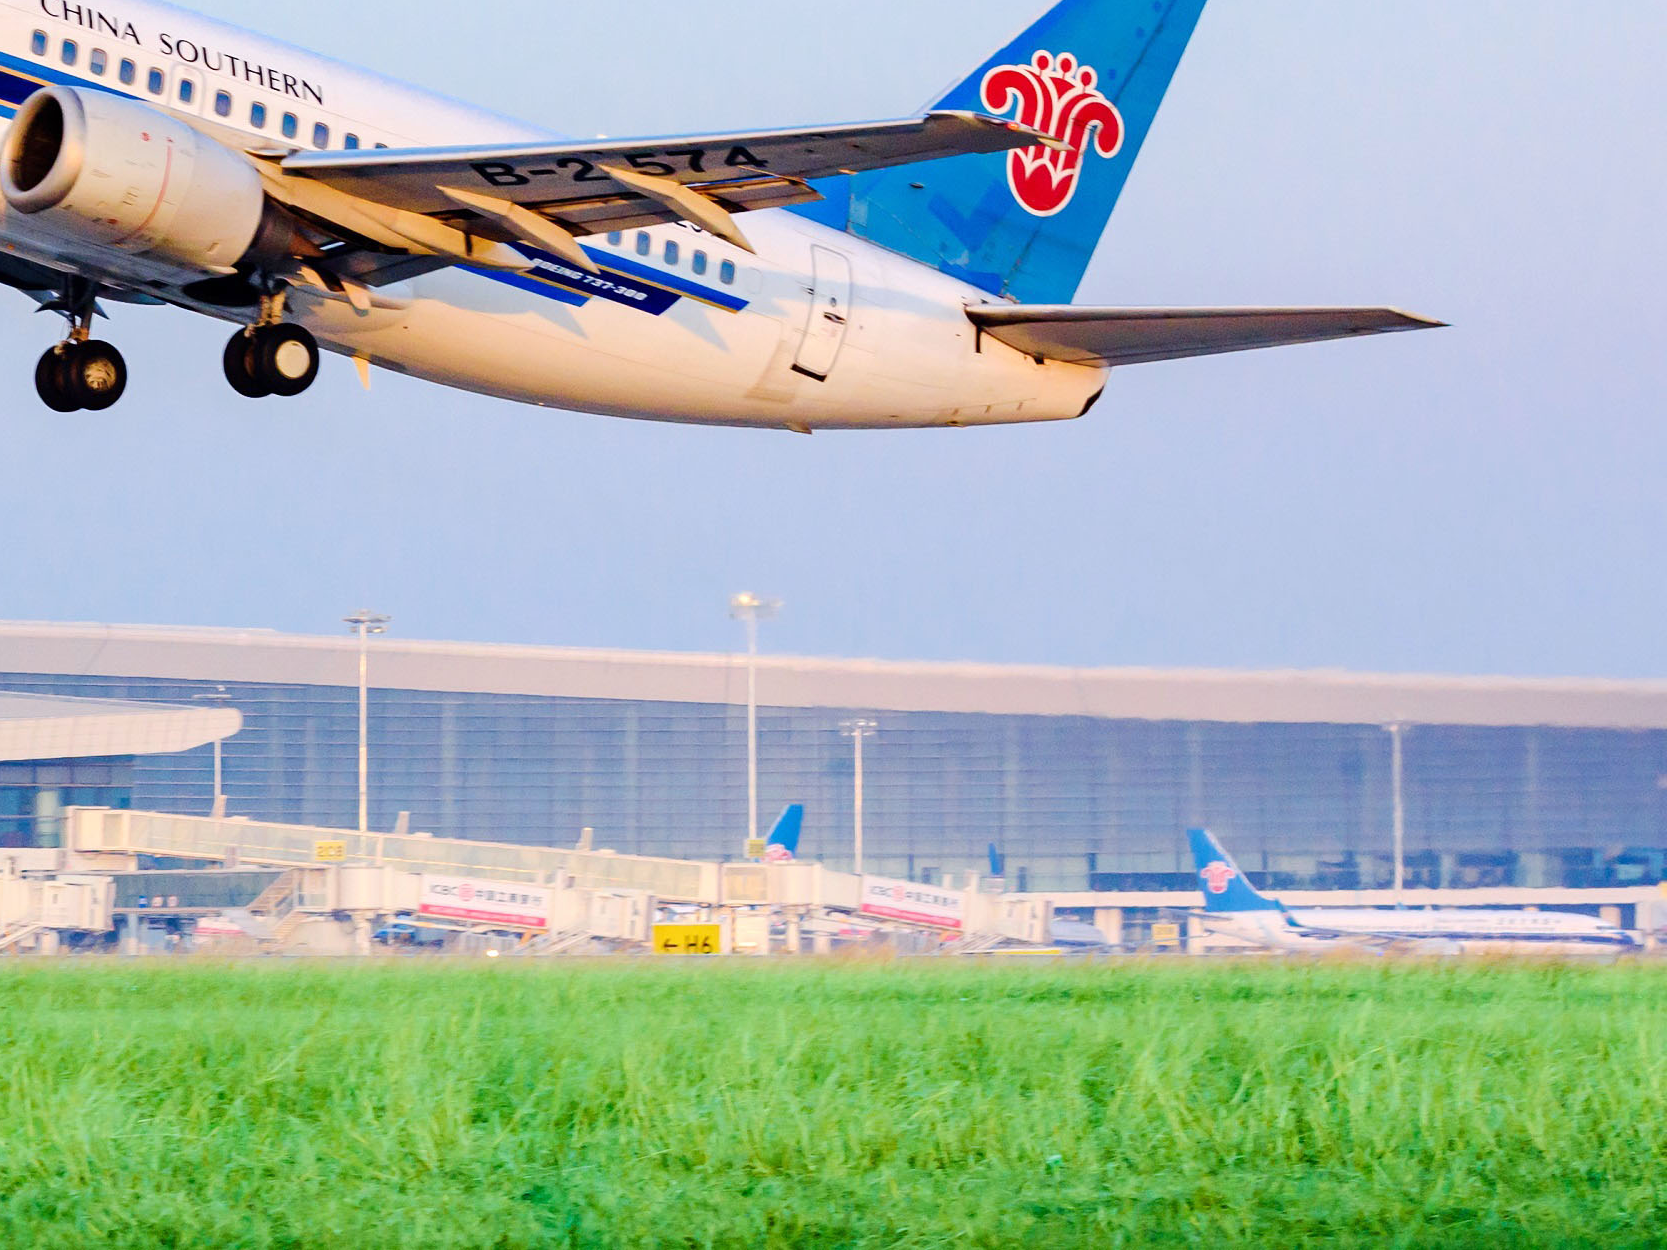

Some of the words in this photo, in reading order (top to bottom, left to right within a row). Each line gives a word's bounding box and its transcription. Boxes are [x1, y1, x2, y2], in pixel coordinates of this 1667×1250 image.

[159, 33, 324, 106] SOUTHERN
[469, 145, 770, 187] B-2574
[684, 934, 713, 955] H6
